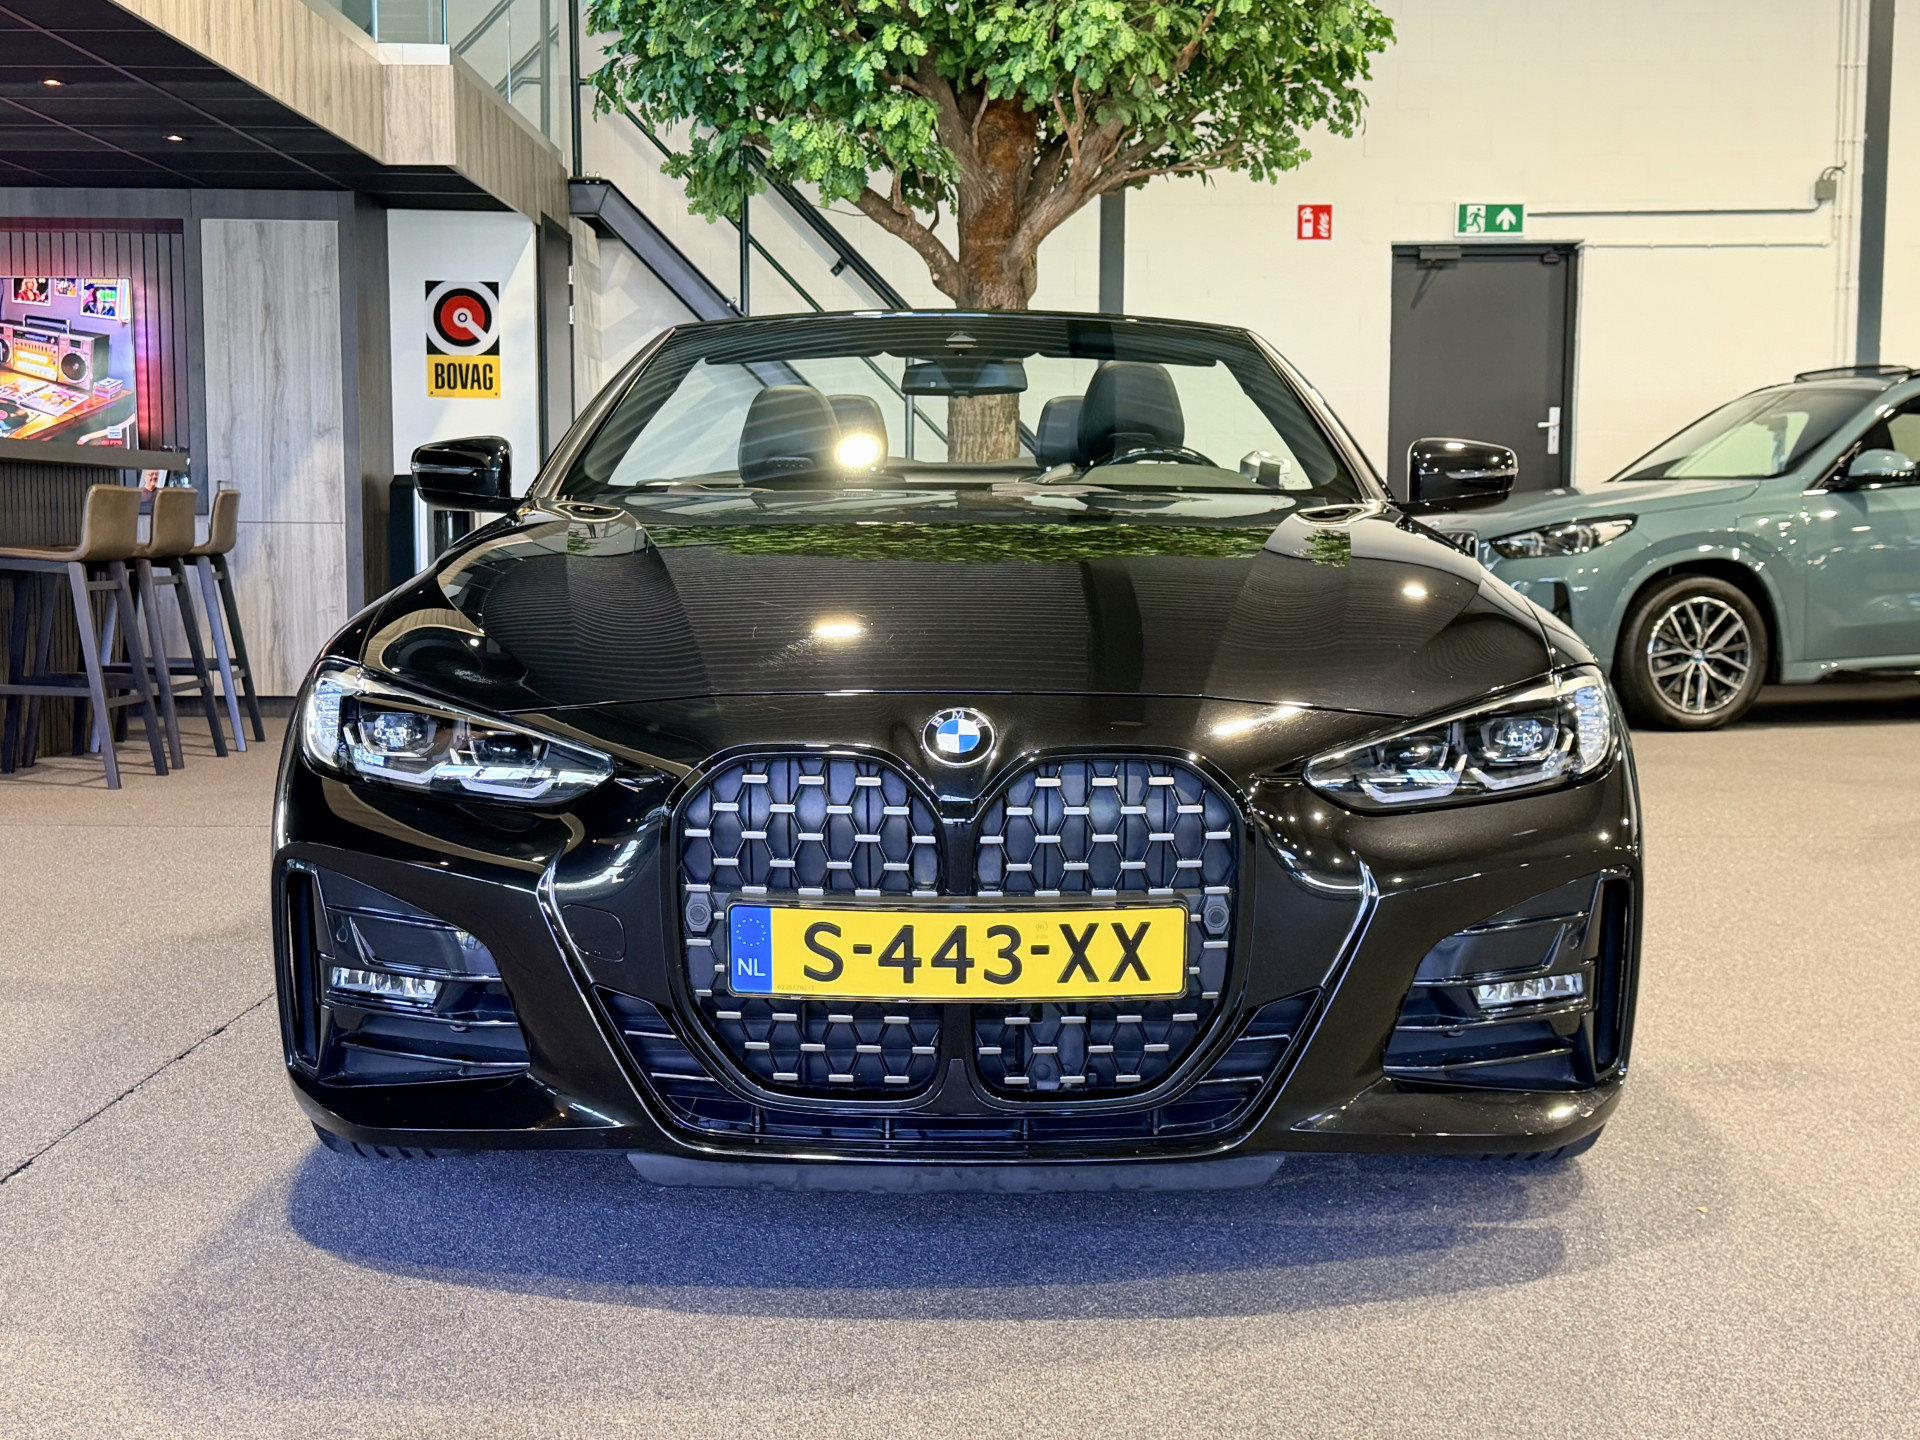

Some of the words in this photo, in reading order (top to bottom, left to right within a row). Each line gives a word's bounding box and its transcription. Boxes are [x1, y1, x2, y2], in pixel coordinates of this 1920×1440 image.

[434, 362, 494, 391] BOVAG
[931, 709, 988, 729] BMW
[803, 920, 1152, 985] S-443-XX
[737, 957, 767, 977] NL
